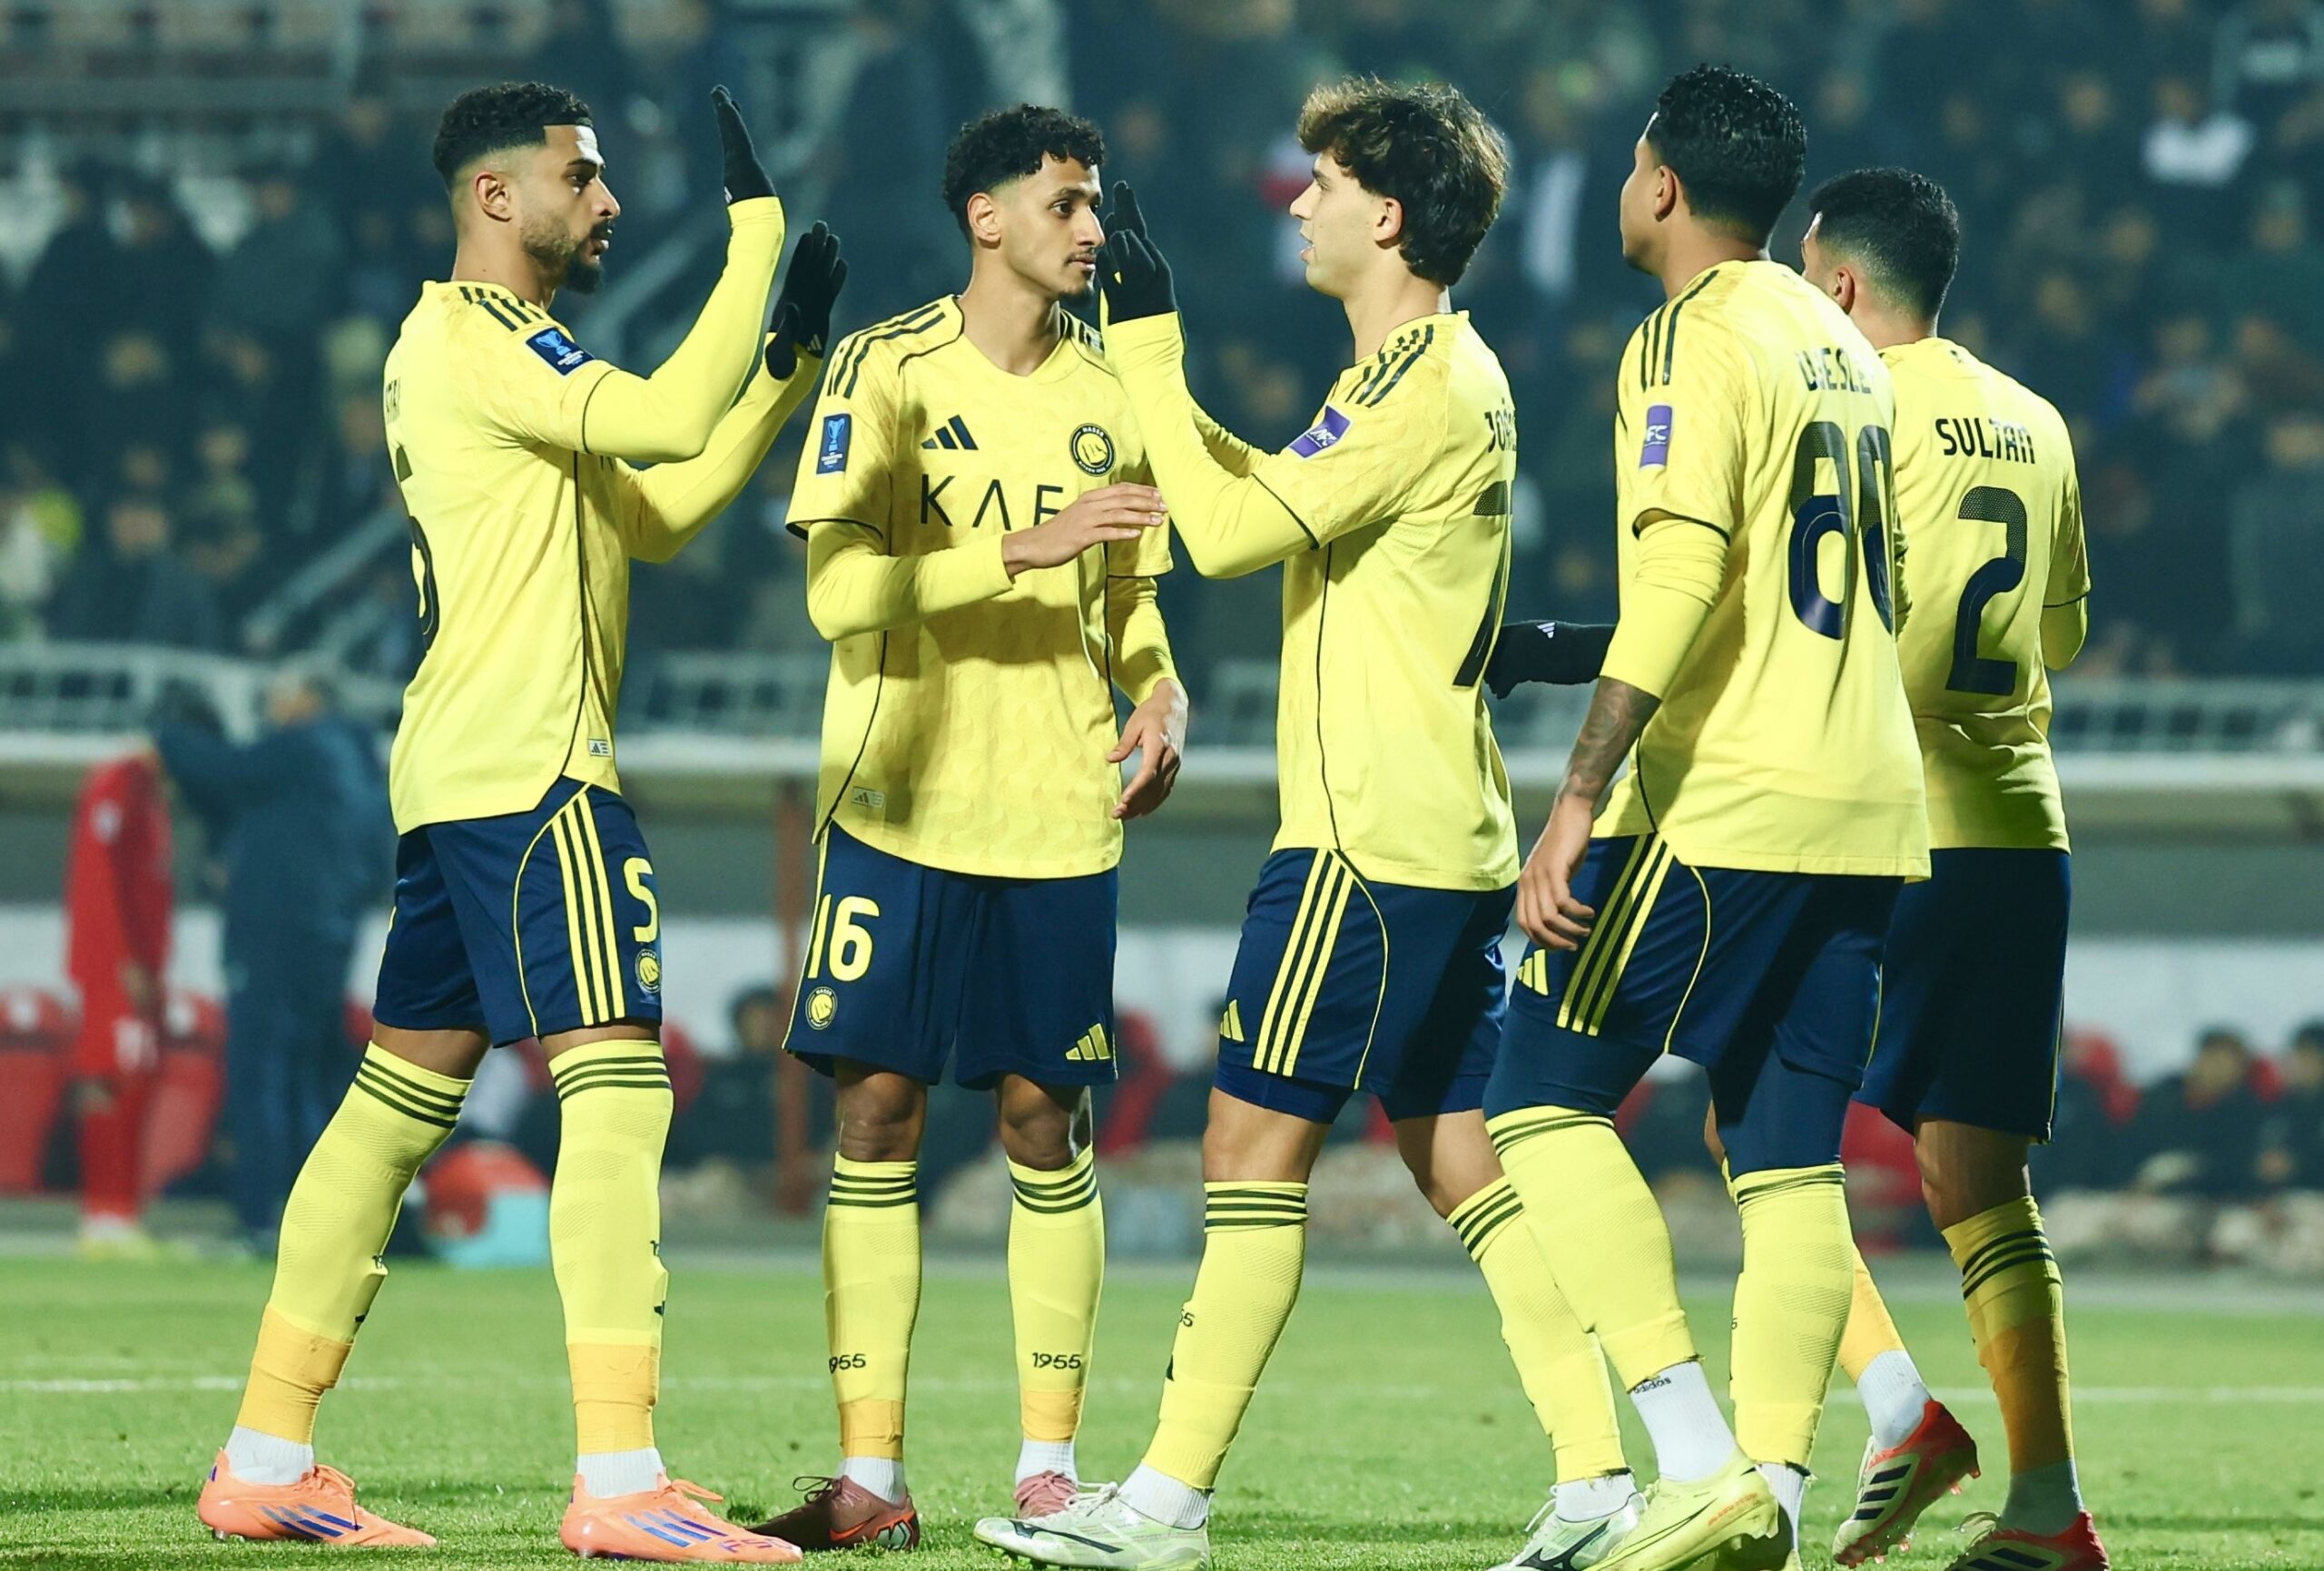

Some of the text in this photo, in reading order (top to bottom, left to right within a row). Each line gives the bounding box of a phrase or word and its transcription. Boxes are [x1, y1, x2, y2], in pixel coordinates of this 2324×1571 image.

[1796, 348, 1881, 394] WESLE
[1309, 428, 1337, 447] AFC
[1935, 417, 2035, 464] SULTAN
[921, 474, 1064, 531] KAF
[1788, 421, 1894, 641] 80
[1945, 486, 2028, 697] 2
[624, 857, 659, 943] 5
[808, 893, 881, 982] 16
[1031, 1351, 1082, 1370] 1955
